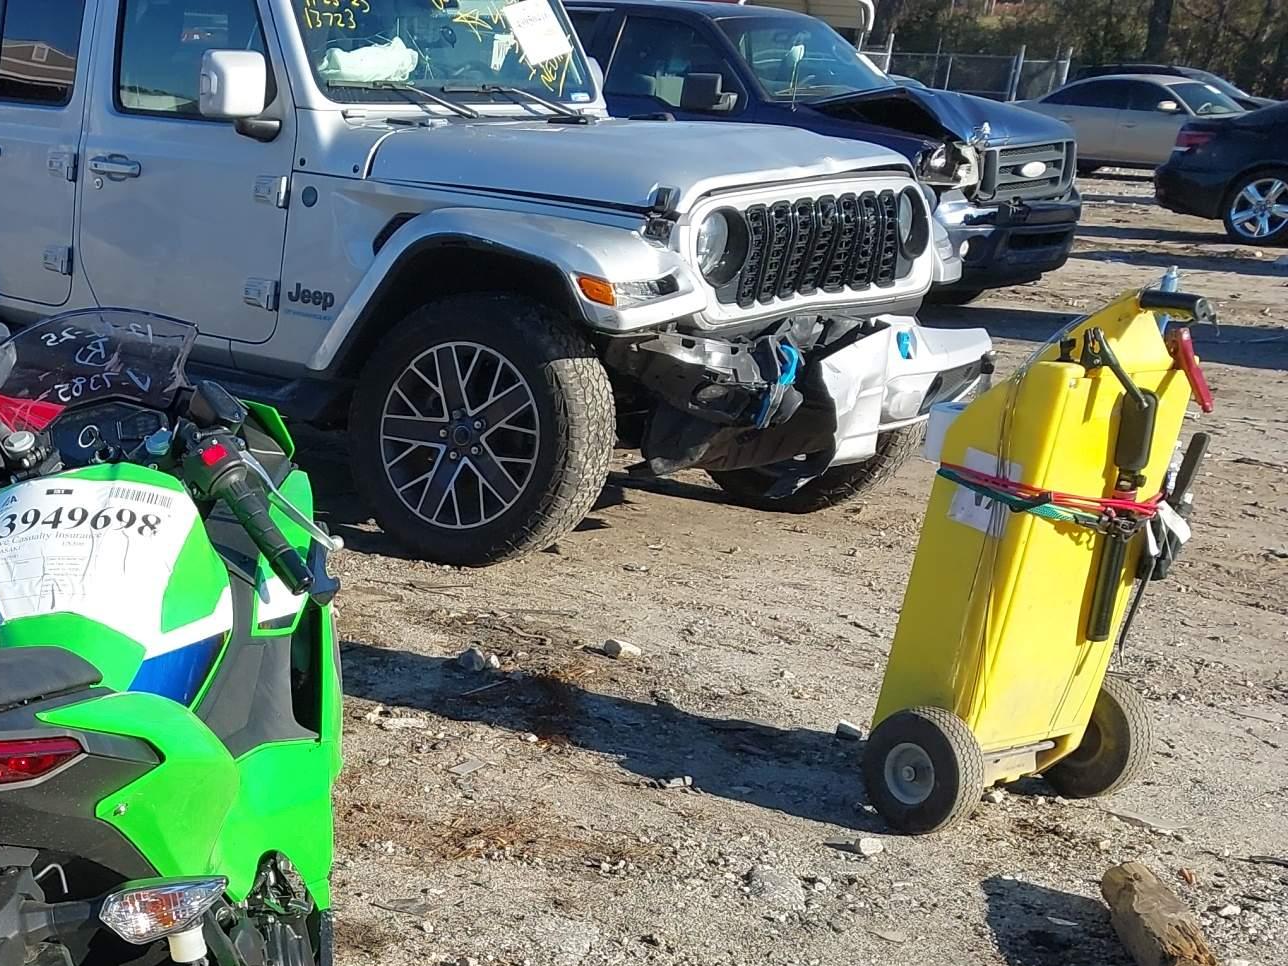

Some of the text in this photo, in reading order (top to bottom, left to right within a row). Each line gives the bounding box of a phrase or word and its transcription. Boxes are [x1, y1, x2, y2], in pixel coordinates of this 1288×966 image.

[304, 7, 357, 29] 13723
[287, 282, 335, 311] Jeep
[12, 532, 51, 545] Casualty
